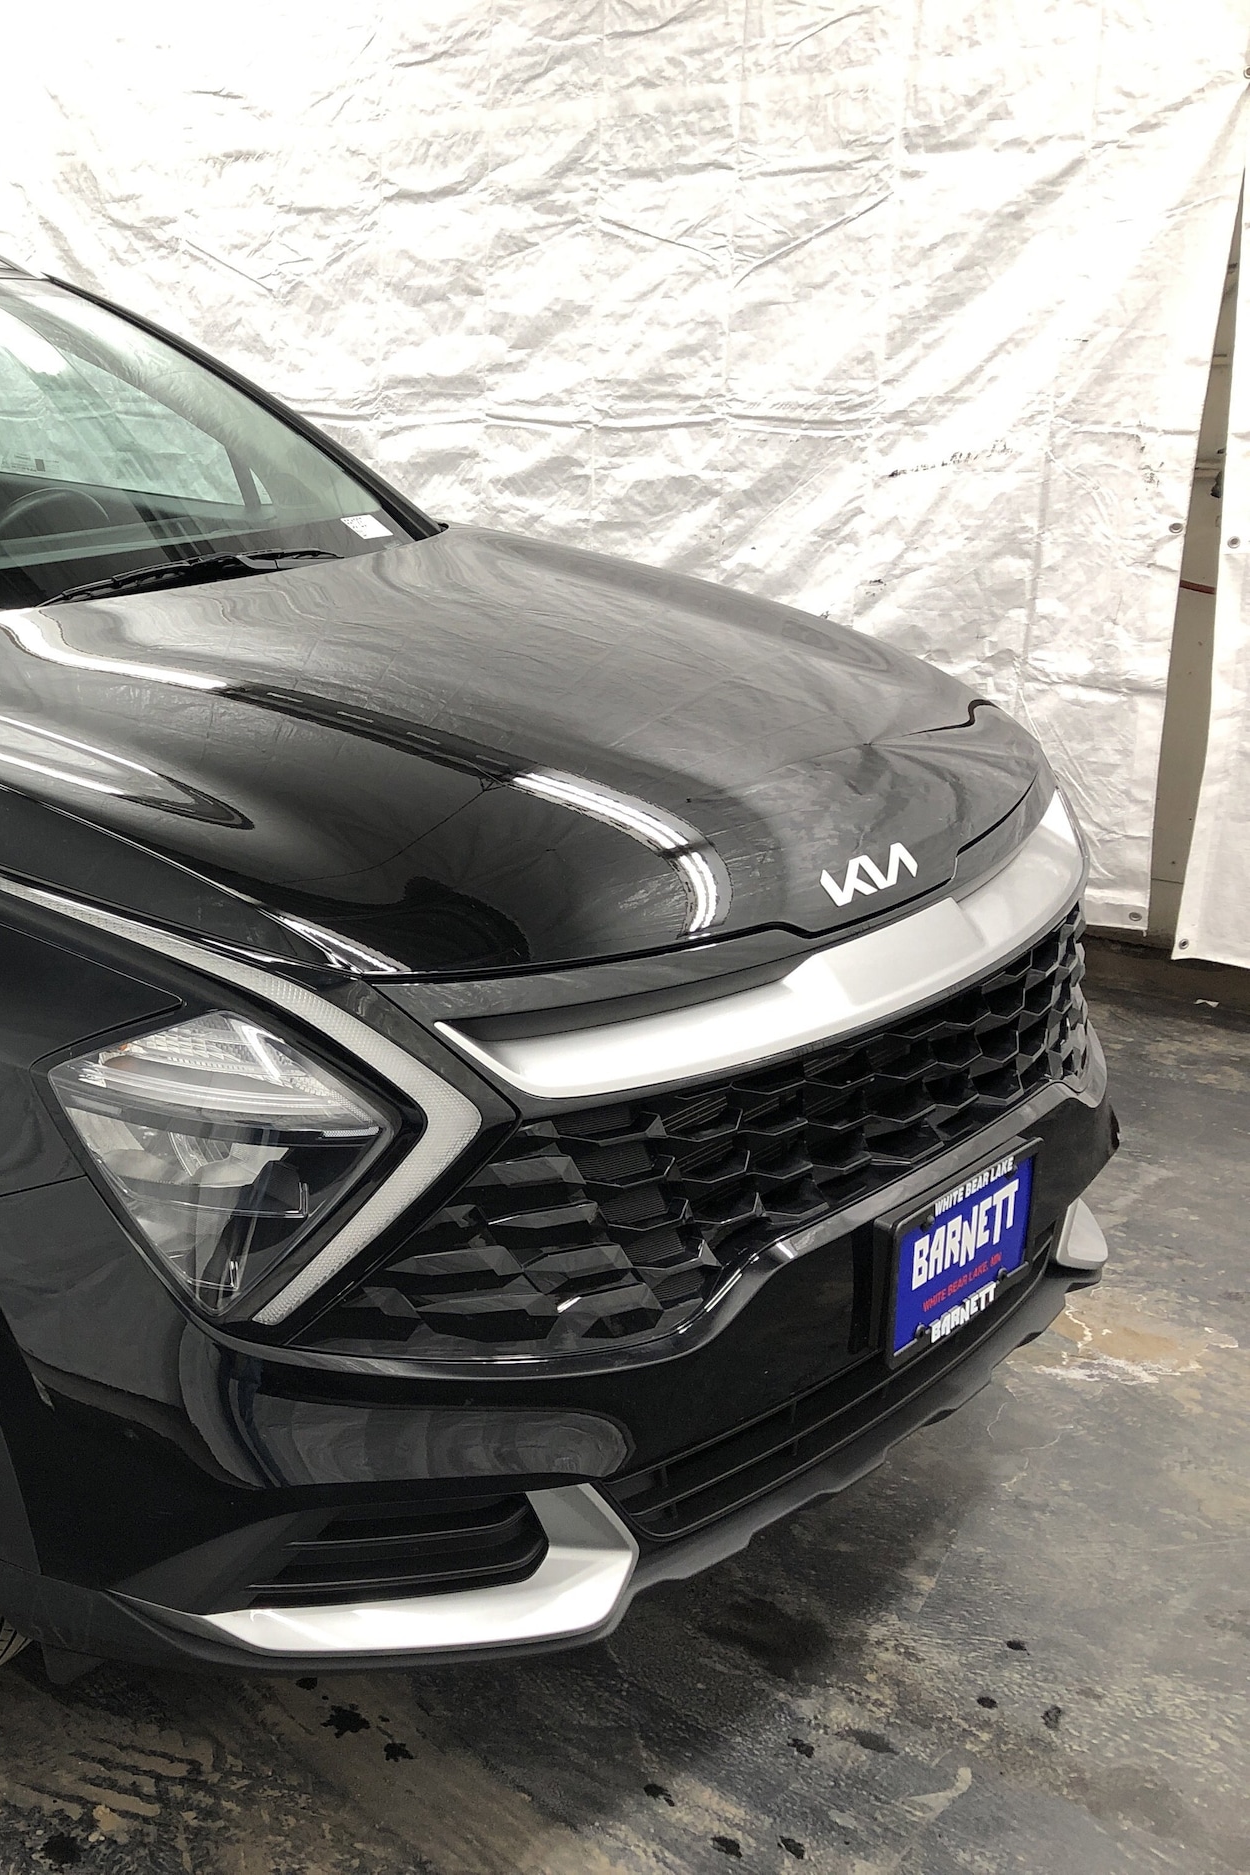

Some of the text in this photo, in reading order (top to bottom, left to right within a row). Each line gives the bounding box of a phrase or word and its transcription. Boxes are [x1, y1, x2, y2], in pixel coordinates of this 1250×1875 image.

[934, 1156, 1015, 1216] WHITE BEAR LAKE
[912, 1179, 1019, 1290] BARNETT
[922, 1289, 947, 1312] WHITE
[947, 1274, 968, 1296] BEAR
[930, 1281, 997, 1343] BARNETT
